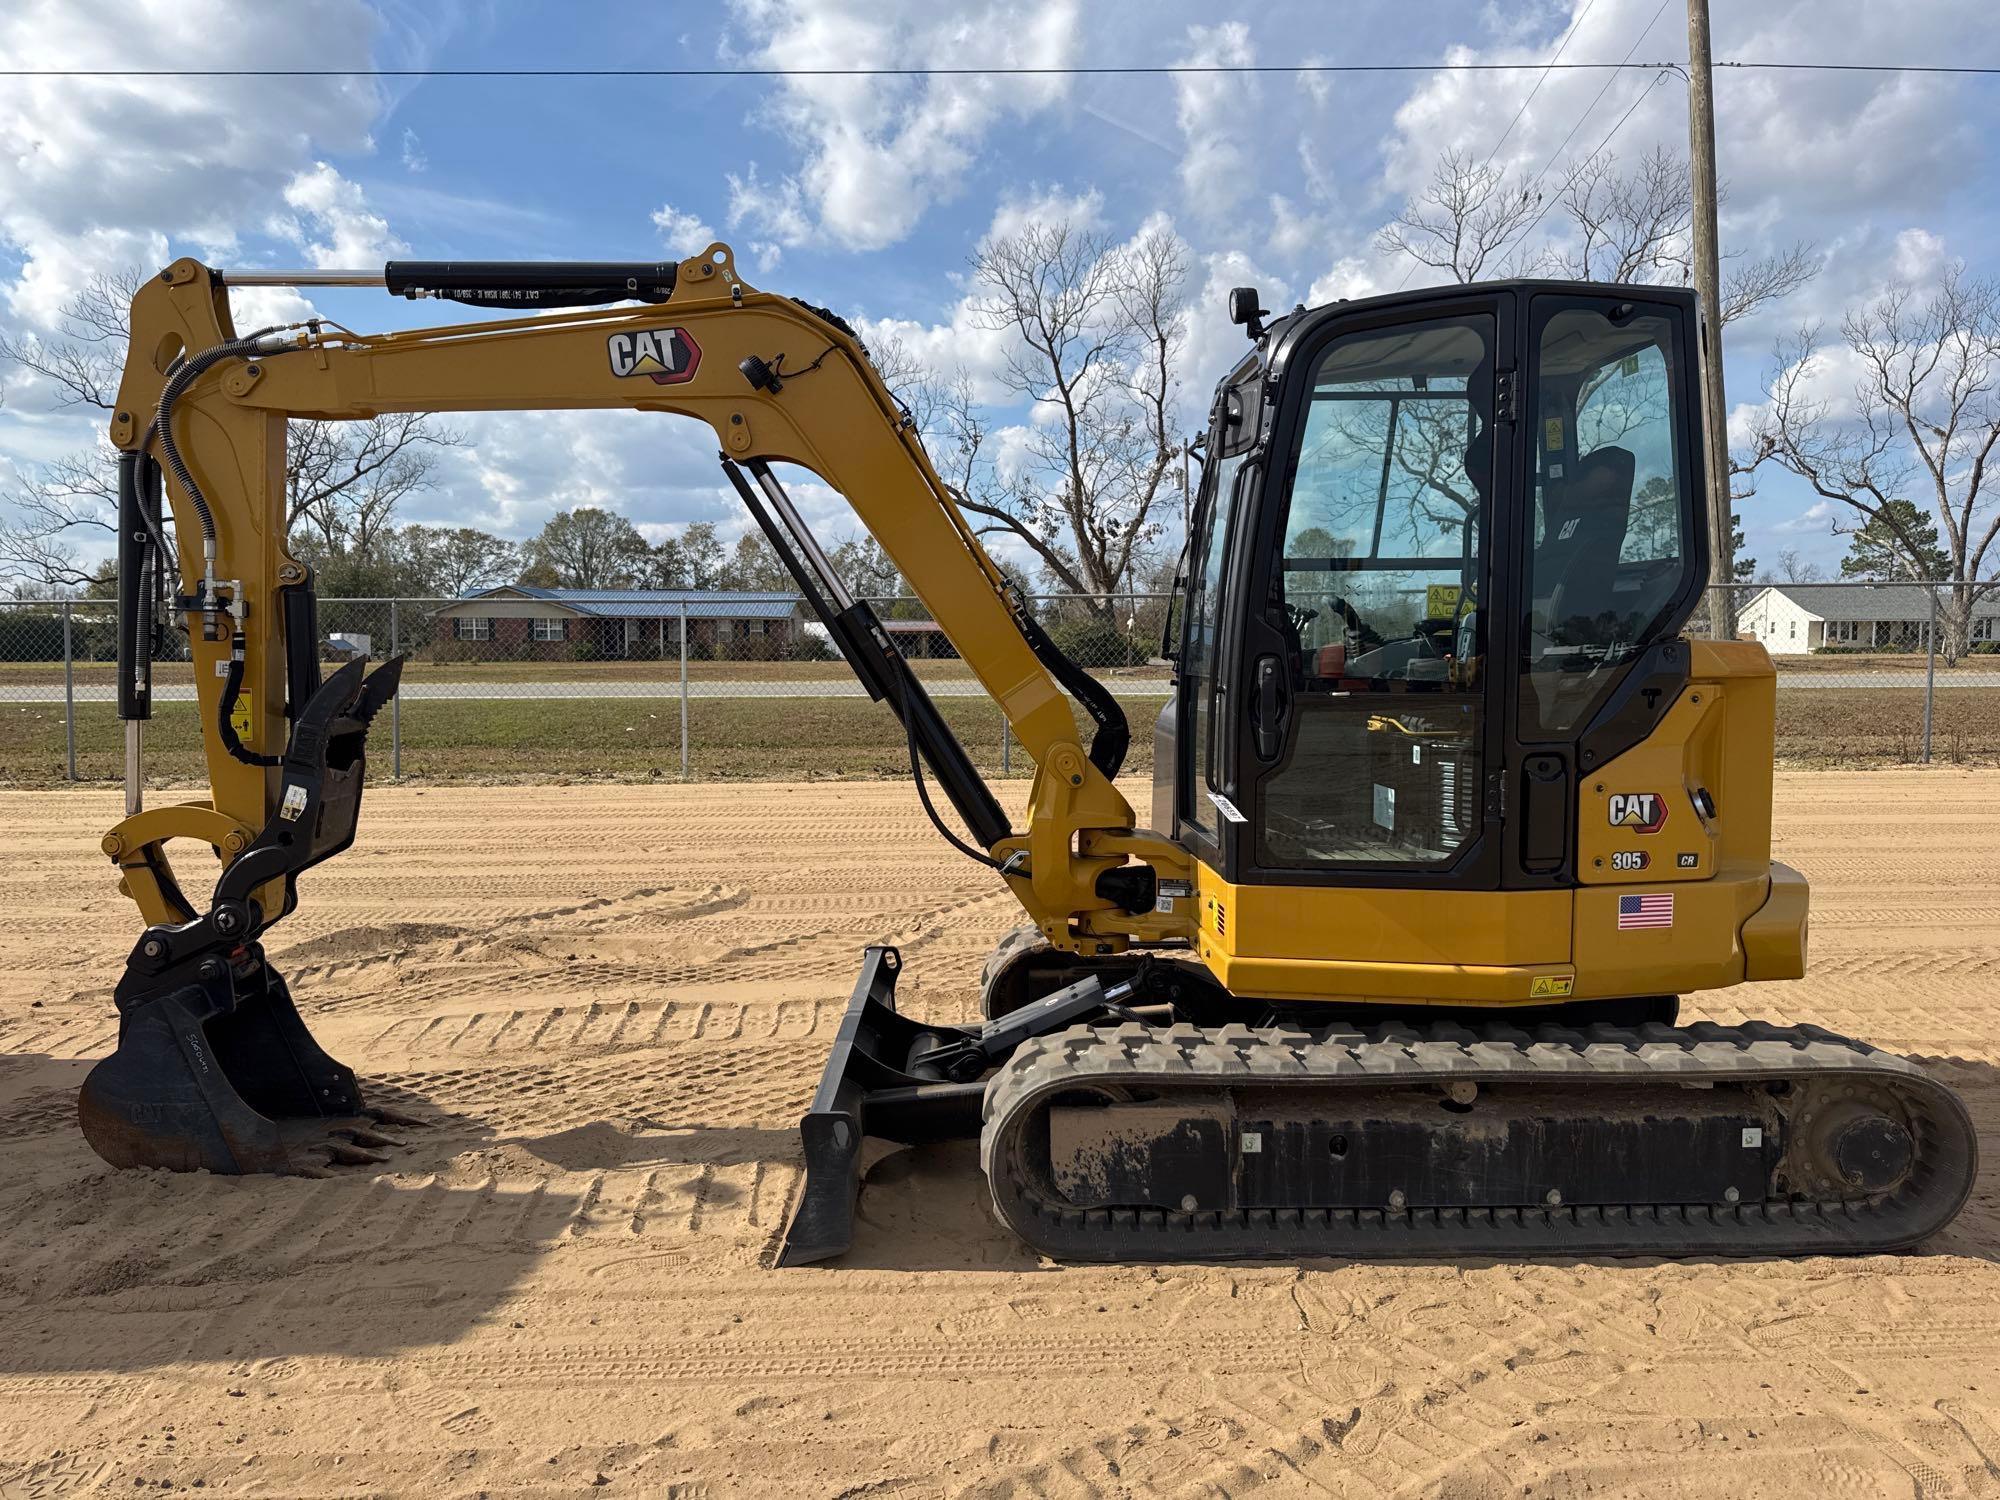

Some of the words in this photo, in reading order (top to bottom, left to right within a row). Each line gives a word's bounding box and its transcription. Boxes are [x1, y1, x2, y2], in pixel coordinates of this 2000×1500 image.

[525, 290, 540, 299] CAT
[608, 329, 676, 376] CAT
[1558, 518, 1581, 540] CAT
[1609, 794, 1654, 826] CAT
[1612, 852, 1641, 870] 305
[1681, 855, 1695, 867] CR
